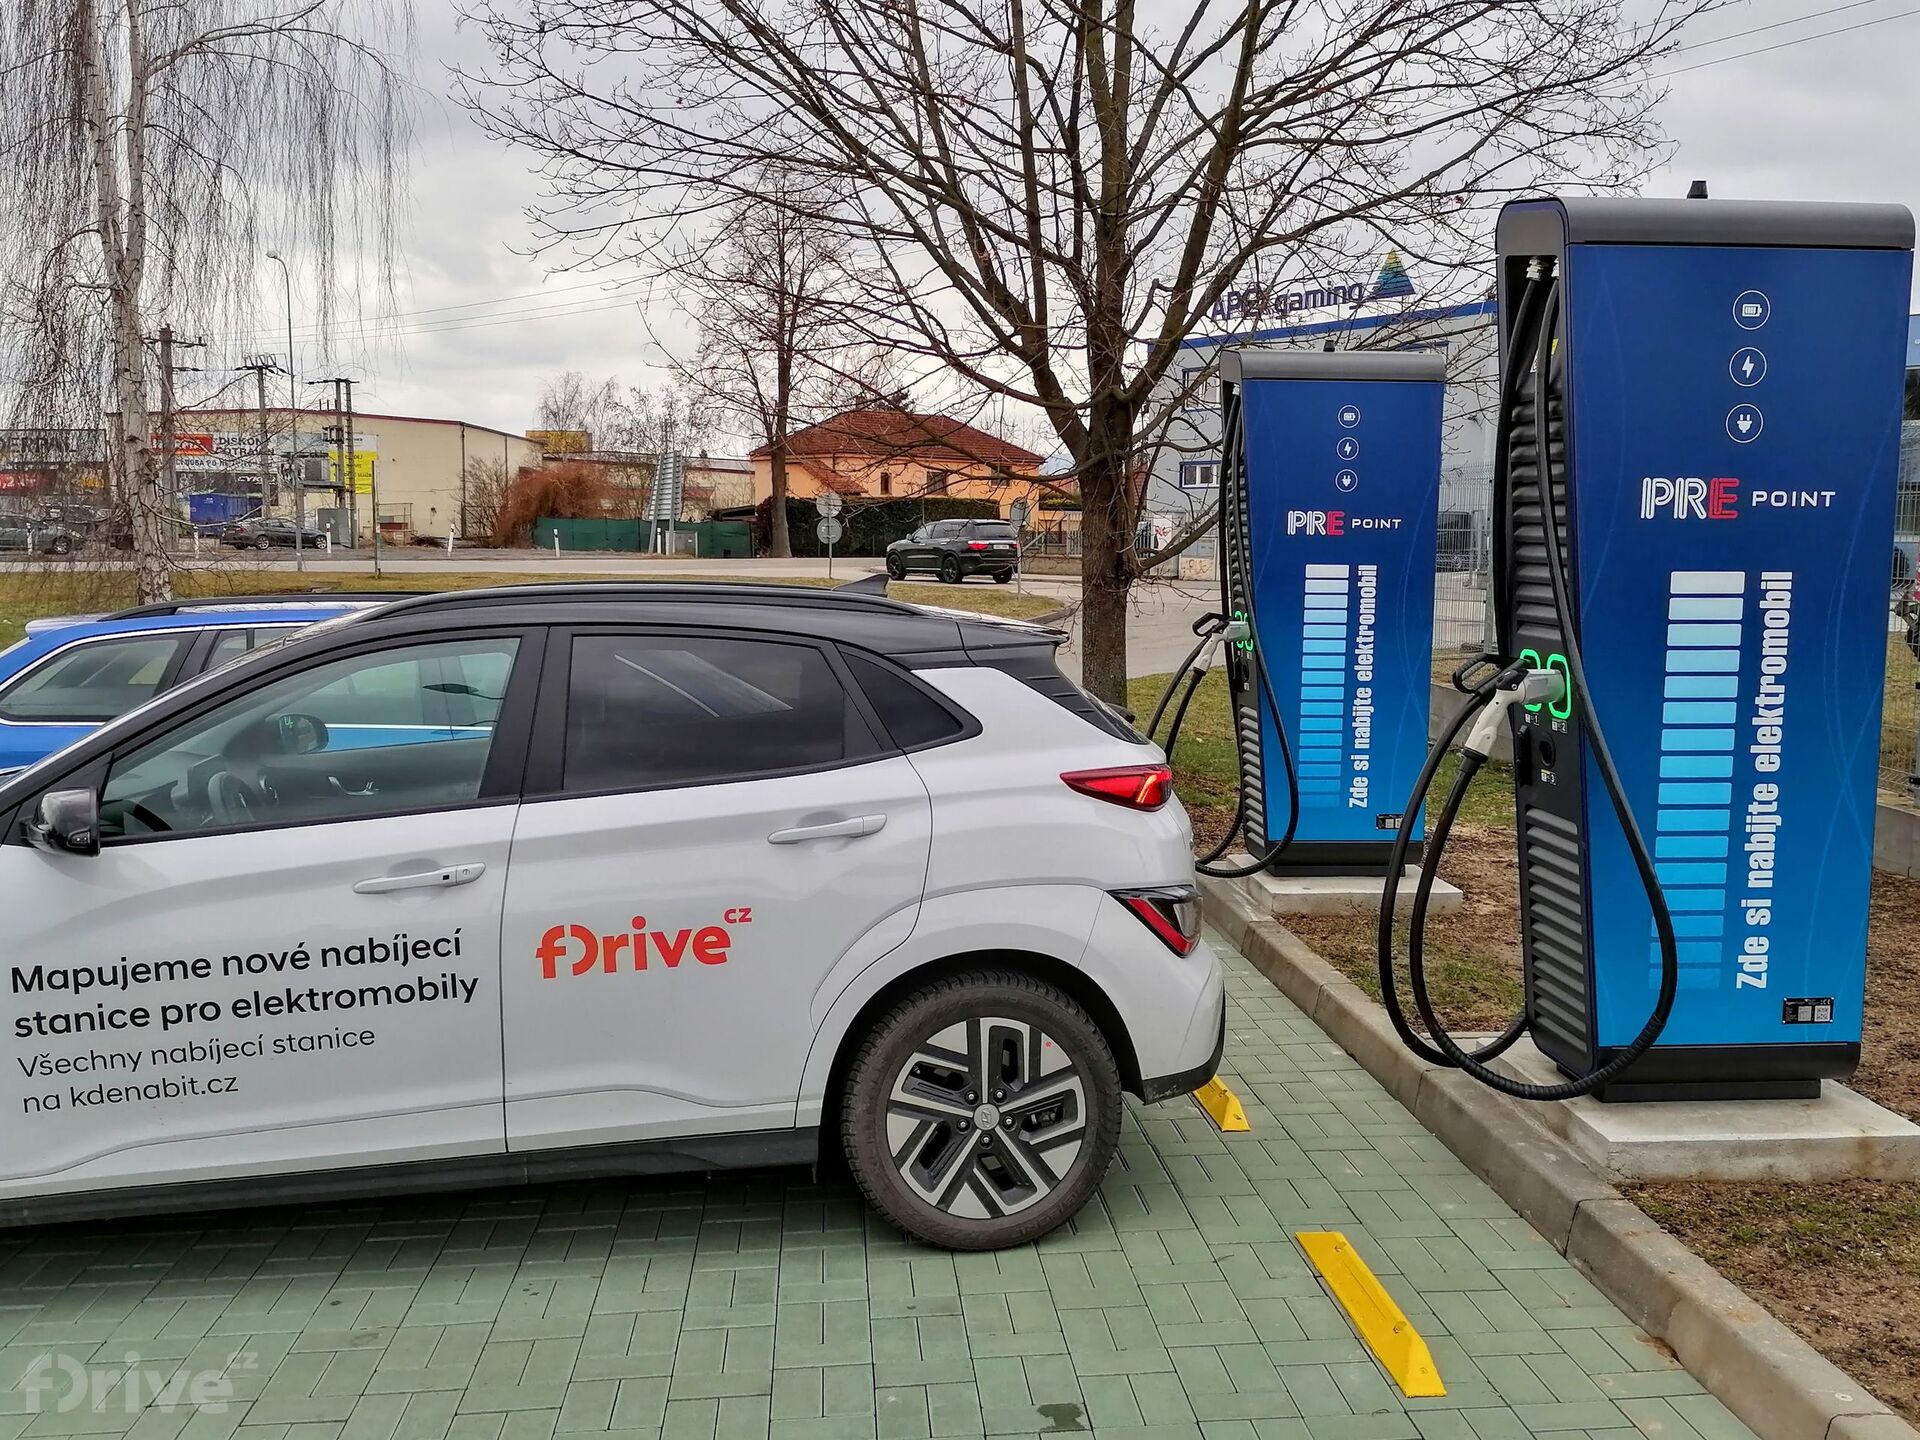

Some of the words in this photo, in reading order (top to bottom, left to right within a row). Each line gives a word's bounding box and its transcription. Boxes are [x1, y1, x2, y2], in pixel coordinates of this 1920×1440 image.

[1273, 280, 1363, 320] gaming
[219, 437, 268, 447] DISKON
[1641, 477, 1740, 519] PRE
[1752, 490, 1836, 507] POINT
[1287, 510, 1345, 536] PRE
[1351, 518, 1402, 529] POINT
[1354, 565, 1378, 682] elektromobil
[1750, 571, 1793, 773] elektromobil
[1352, 687, 1375, 749] nabijte
[1351, 755, 1370, 771] si
[1349, 776, 1369, 808] Zde
[1744, 783, 1782, 888] nabijte
[1741, 899, 1772, 926] si
[11, 957, 212, 995] Mapujeme
[222, 941, 311, 976] nové
[320, 928, 462, 968] nabíjecí
[1736, 936, 1770, 989] Zde
[14, 1003, 151, 1038] stanice
[160, 1000, 222, 1031] pro
[231, 973, 479, 1018] elektromobily
[16, 1049, 143, 1078] Všechny
[151, 1033, 264, 1066] nabíjecí
[272, 1027, 376, 1054] stanice
[23, 1094, 62, 1113] na
[70, 1075, 239, 1108] kdenabit.cz
